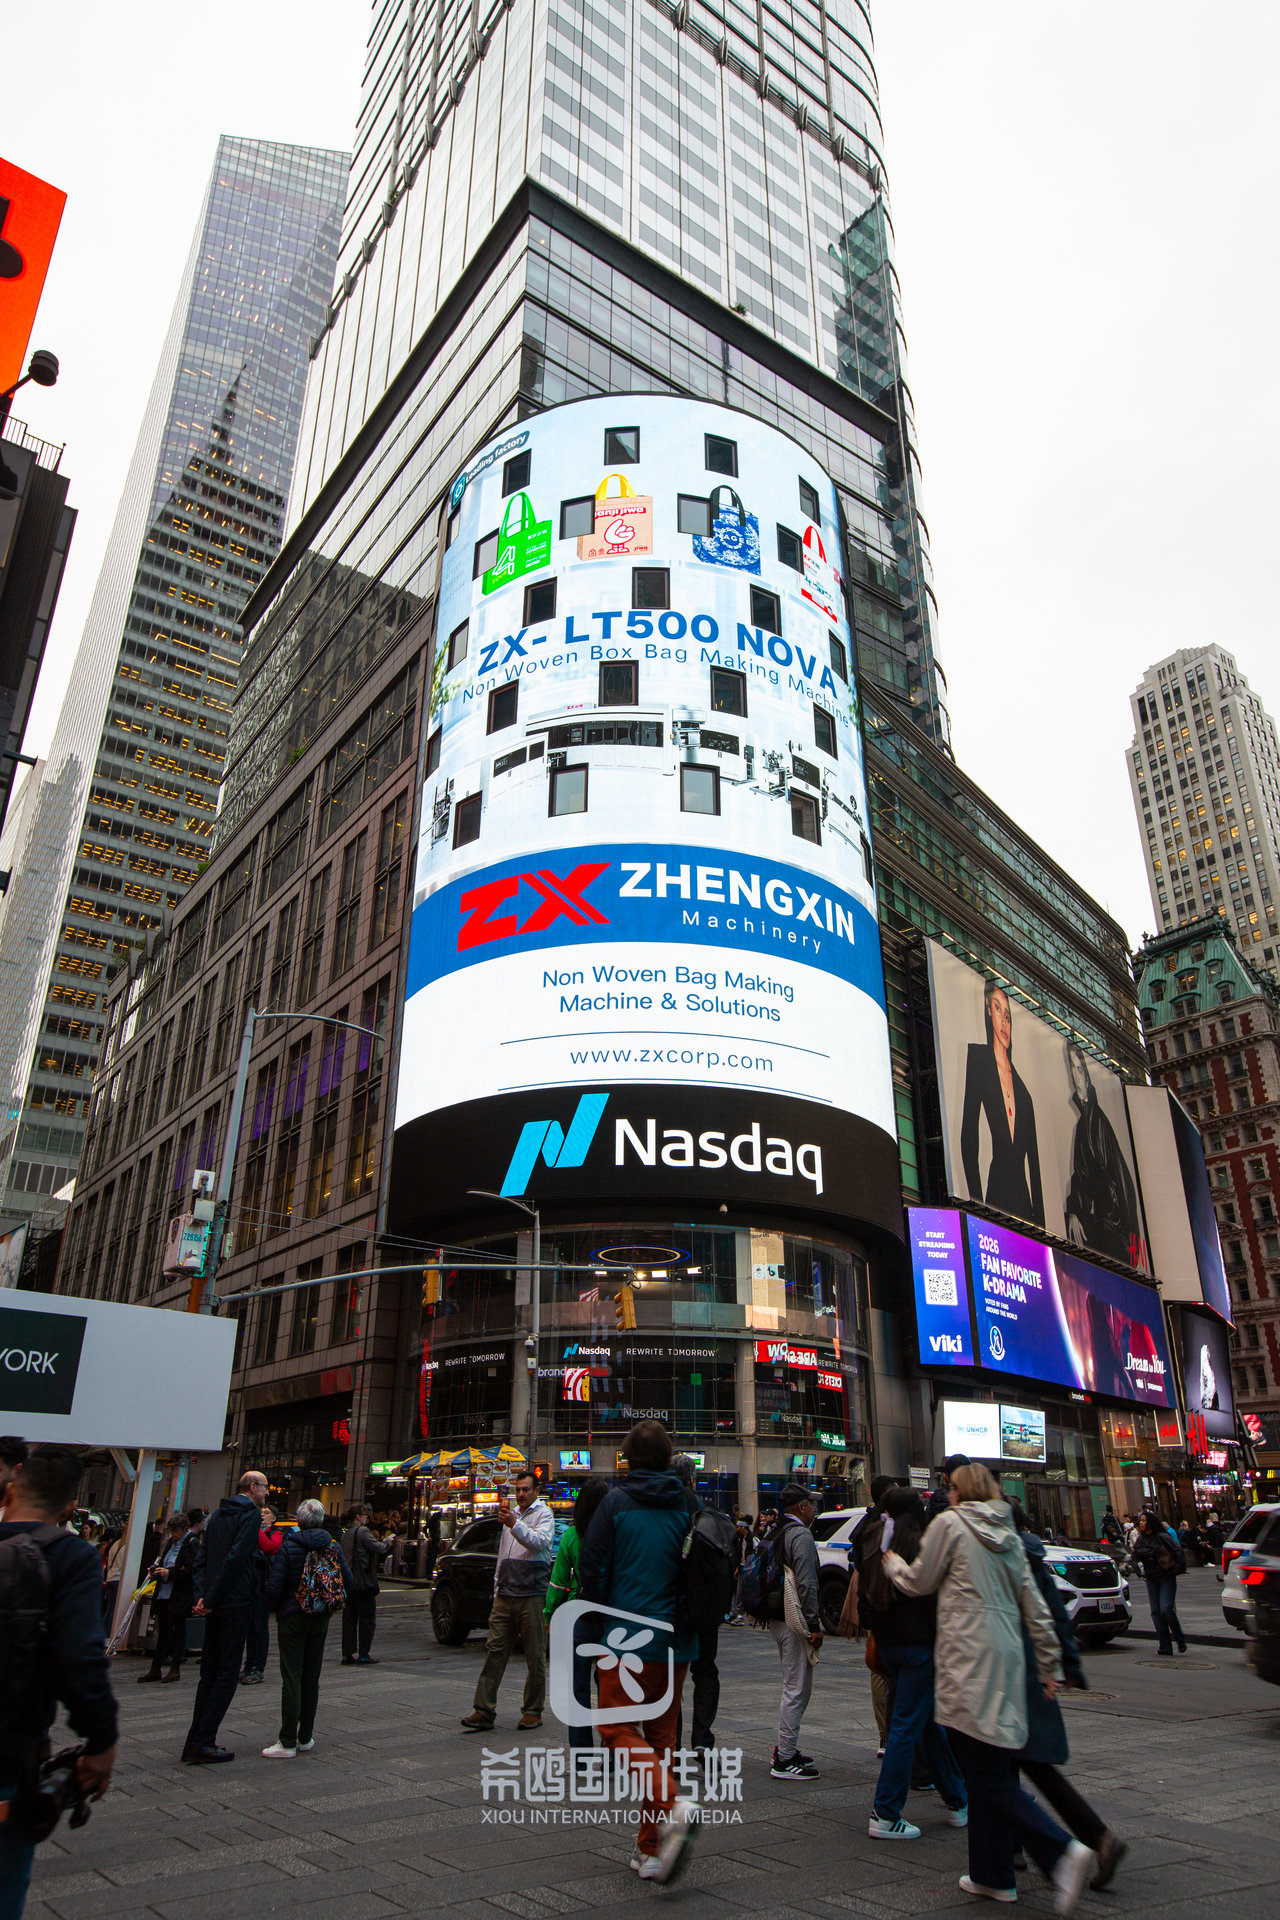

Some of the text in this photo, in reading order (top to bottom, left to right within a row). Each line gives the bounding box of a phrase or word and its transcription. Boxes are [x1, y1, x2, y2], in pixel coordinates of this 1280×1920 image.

[465, 434, 527, 483] Leading factory
[564, 610, 720, 645] LT500
[736, 622, 838, 700] NOVA
[462, 643, 849, 729] Non Woven Box Bag Making Machine
[457, 862, 855, 953] ZX ZHENGXIN
[682, 910, 821, 954] Machinery
[542, 965, 795, 1003] Non Woven Bag Making
[560, 992, 781, 1022] Machine & Solutions
[570, 1049, 774, 1072] www.zxcorp.com
[614, 1118, 824, 1196] Nasdaq
[918, 1241, 956, 1249] STREAMING
[925, 1231, 945, 1239] START
[978, 1233, 1000, 1255] 2026
[926, 1251, 948, 1259] TODAY
[981, 1252, 1042, 1290] FAN FAVORITE
[982, 1273, 1027, 1304] K-DRAMA
[445, 1356, 467, 1367] REWRITE
[469, 1352, 506, 1364] TOMORROW
[578, 1346, 716, 1357] Nasdaq REWRITE TOMORROW
[1124, 1352, 1149, 1373] Dream
[1152, 1354, 1167, 1375] You
[623, 1408, 669, 1421] Nasdaq
[966, 1426, 988, 1434] UNHCR
